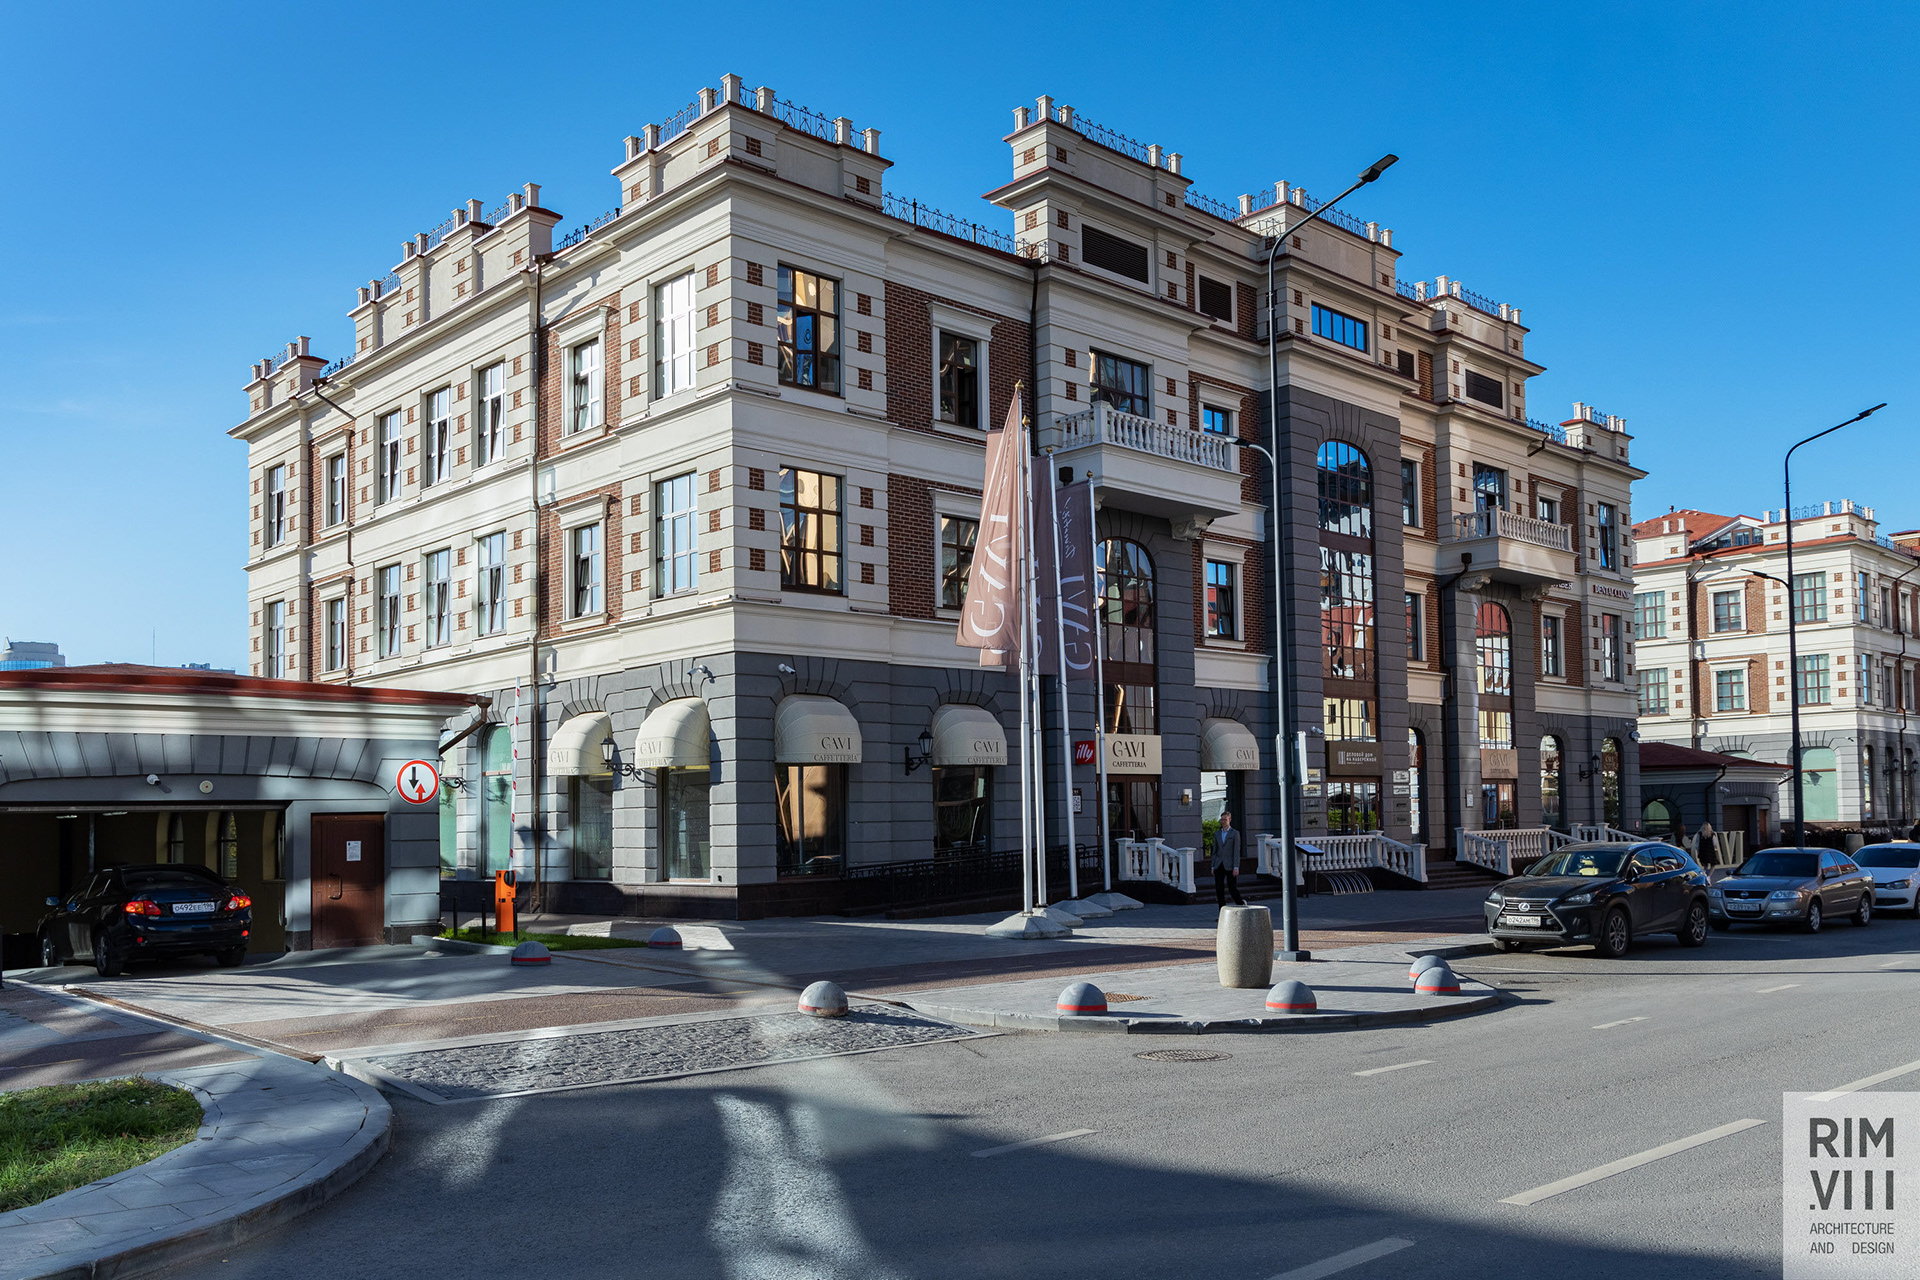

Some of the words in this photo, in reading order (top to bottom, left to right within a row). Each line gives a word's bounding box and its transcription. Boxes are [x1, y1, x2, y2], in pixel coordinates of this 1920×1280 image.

[821, 736, 851, 750] GAVI
[973, 740, 999, 753] GAVI
[1112, 741, 1146, 758] GAVI
[1076, 744, 1094, 762] illy
[1236, 749, 1255, 760] GAVI
